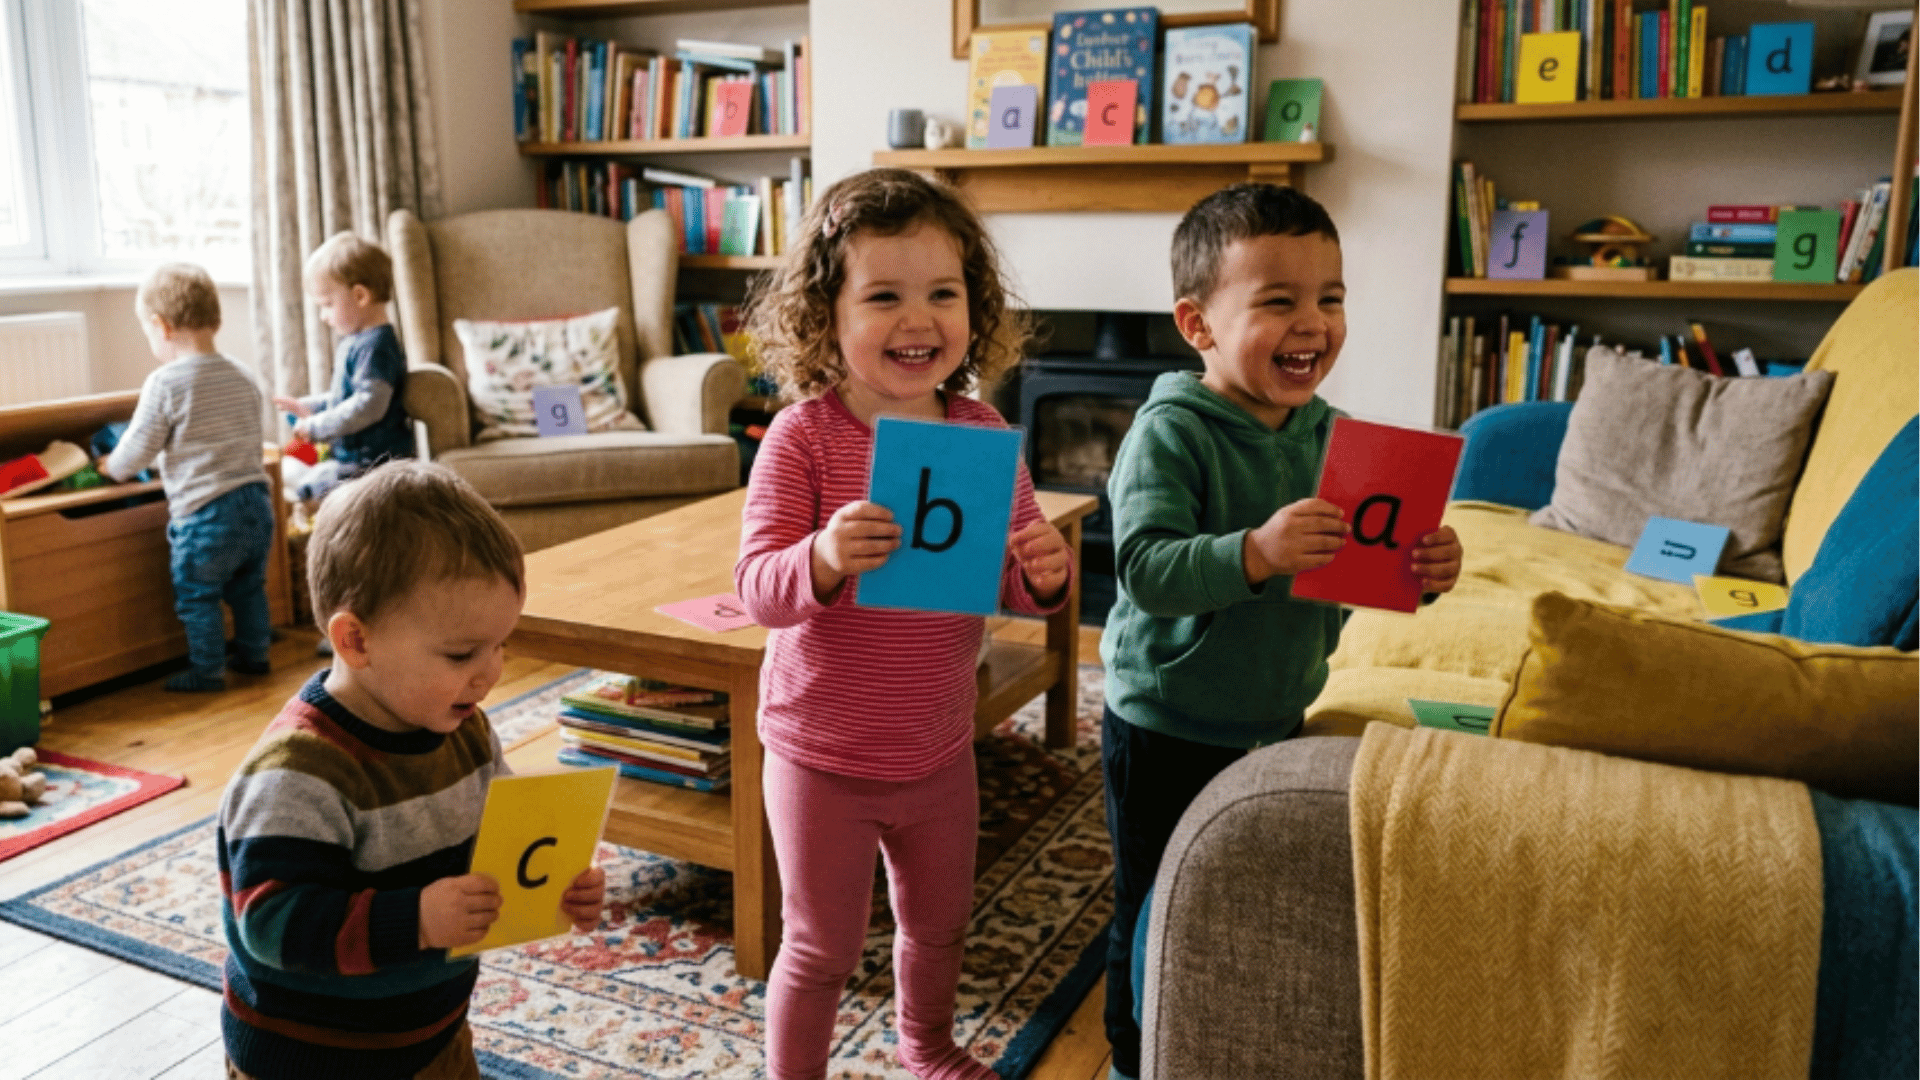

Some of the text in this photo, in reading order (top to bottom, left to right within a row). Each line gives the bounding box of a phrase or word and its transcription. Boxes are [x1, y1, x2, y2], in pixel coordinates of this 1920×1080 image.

[1538, 57, 1559, 81] e
[1766, 36, 1792, 74] d
[1002, 107, 1020, 129] a
[1101, 102, 1119, 126] c
[1281, 100, 1302, 123] o
[1504, 221, 1529, 269] f
[1793, 232, 1818, 271] g
[549, 403, 569, 428] g
[911, 466, 963, 553] b
[1353, 493, 1402, 550] a
[516, 836, 559, 890] c
